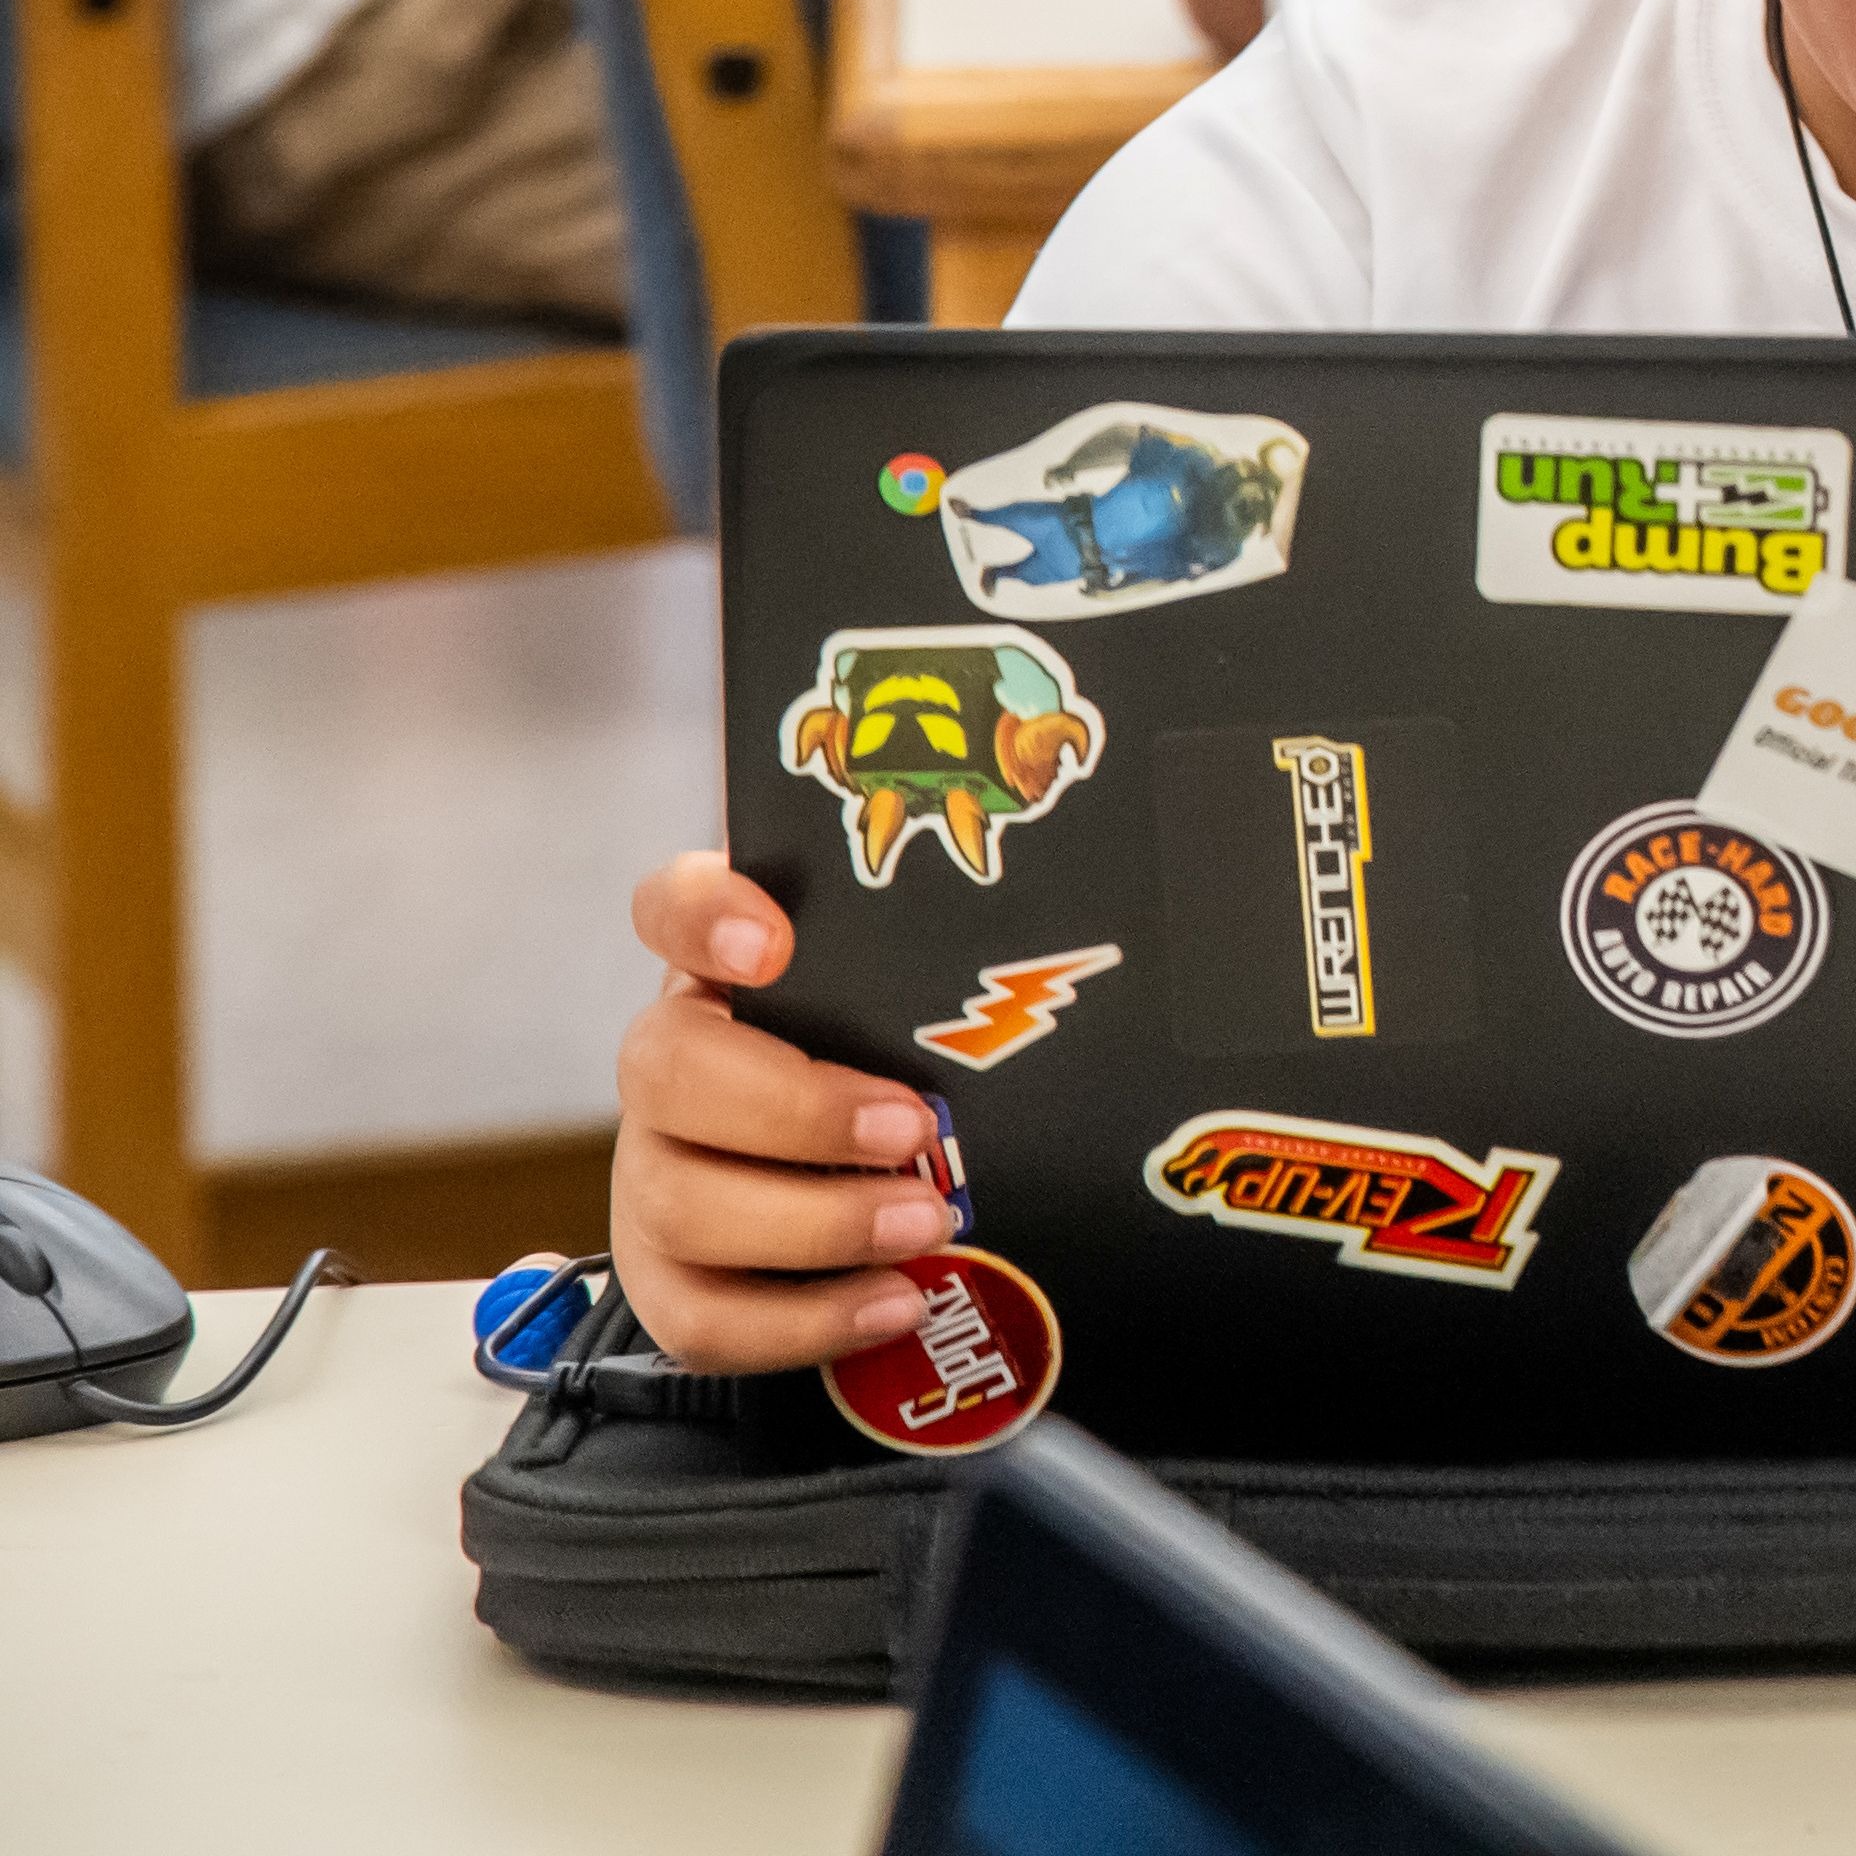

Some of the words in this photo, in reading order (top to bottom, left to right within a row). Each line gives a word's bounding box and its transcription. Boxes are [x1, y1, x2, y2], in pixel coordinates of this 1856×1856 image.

[1552, 506, 1827, 596] Bump
[1593, 928, 1657, 997] AUTO
[1660, 960, 1774, 1012] REPAIR
[1225, 1159, 1537, 1273] REV-UP
